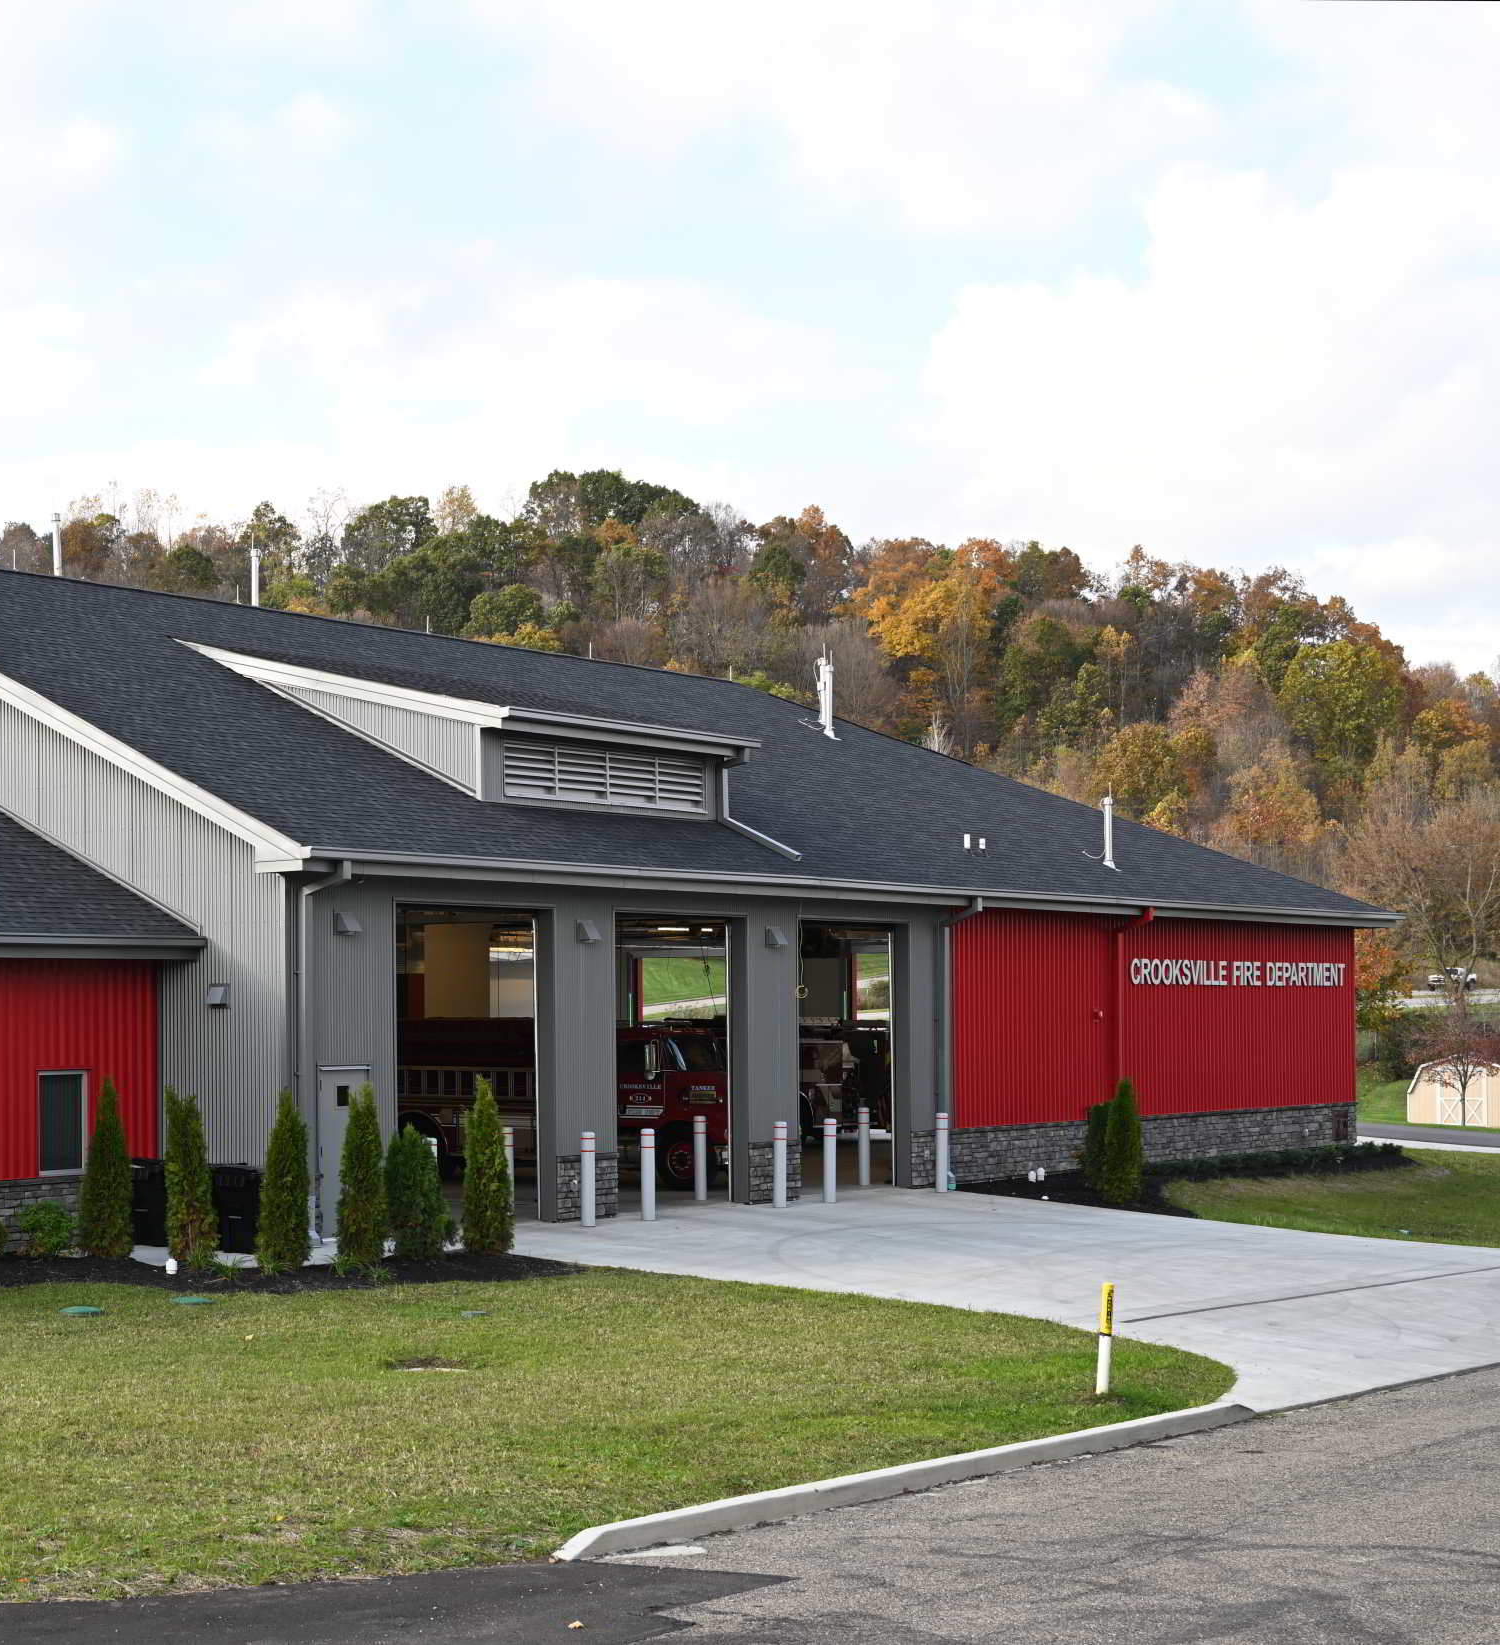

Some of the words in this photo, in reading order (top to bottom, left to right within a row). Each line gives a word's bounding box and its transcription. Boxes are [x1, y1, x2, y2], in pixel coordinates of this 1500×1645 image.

[1130, 958, 1228, 986] CROOKSVILLE
[1232, 961, 1262, 986] FIRE
[1266, 962, 1347, 987] DEPARTMENT
